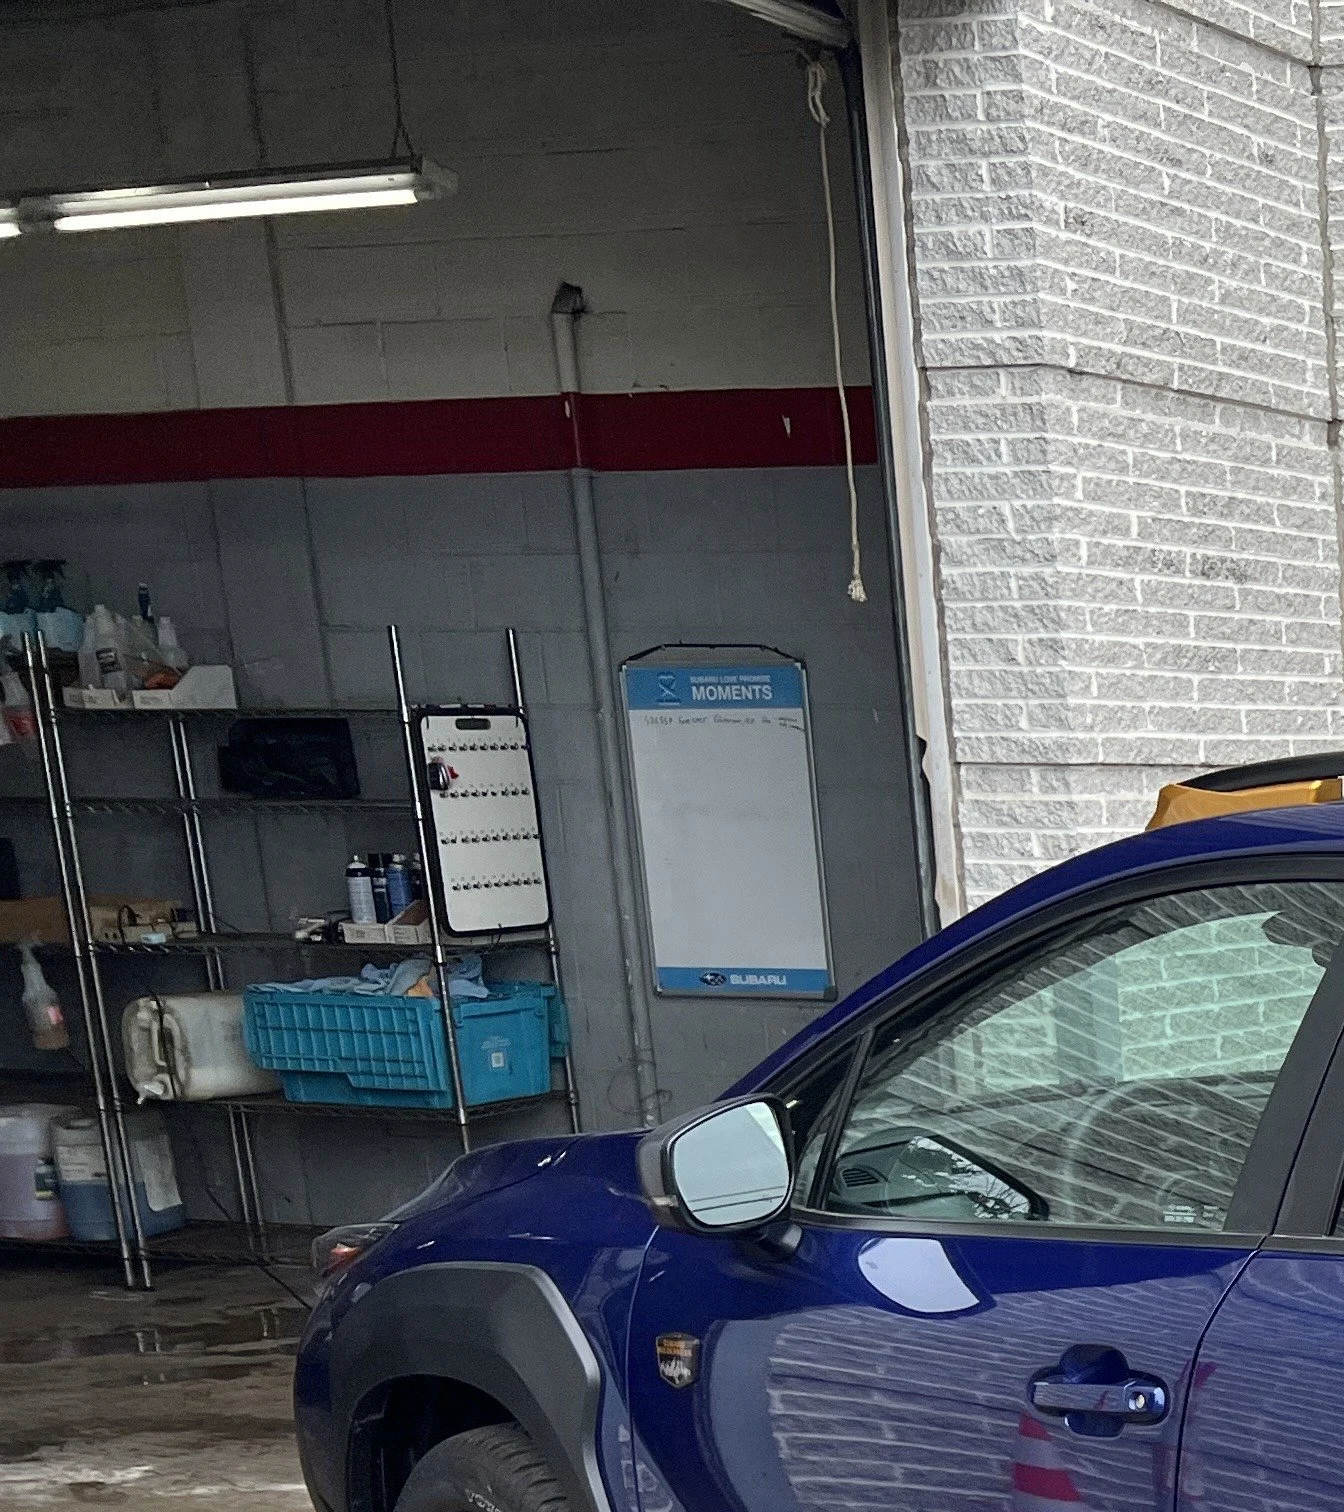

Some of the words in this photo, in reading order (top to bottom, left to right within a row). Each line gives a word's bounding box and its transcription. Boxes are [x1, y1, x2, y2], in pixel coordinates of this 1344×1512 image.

[720, 675, 738, 684] LOVE
[691, 685, 773, 701] MOMENTS
[730, 974, 787, 985] SUBARU
